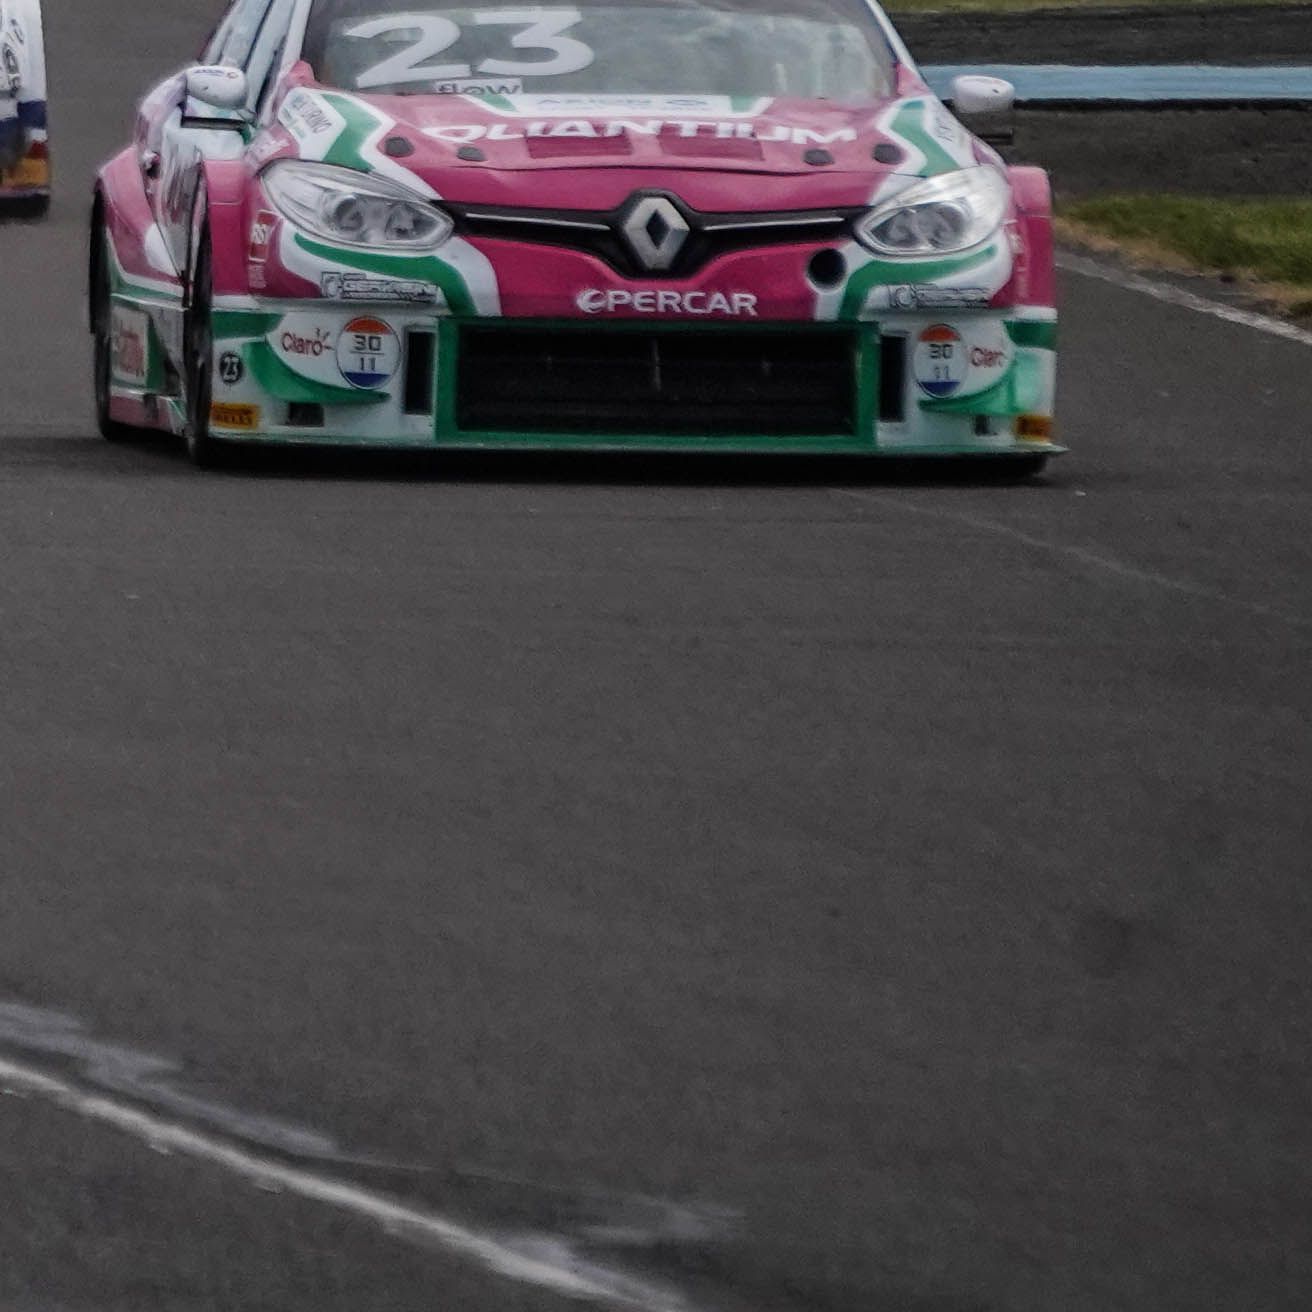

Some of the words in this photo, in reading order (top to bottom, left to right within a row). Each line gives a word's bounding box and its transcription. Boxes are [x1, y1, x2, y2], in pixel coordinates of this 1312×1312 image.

[343, 10, 595, 88] 23
[281, 332, 324, 357] Claro
[352, 334, 382, 352] 30
[360, 356, 377, 372] 11
